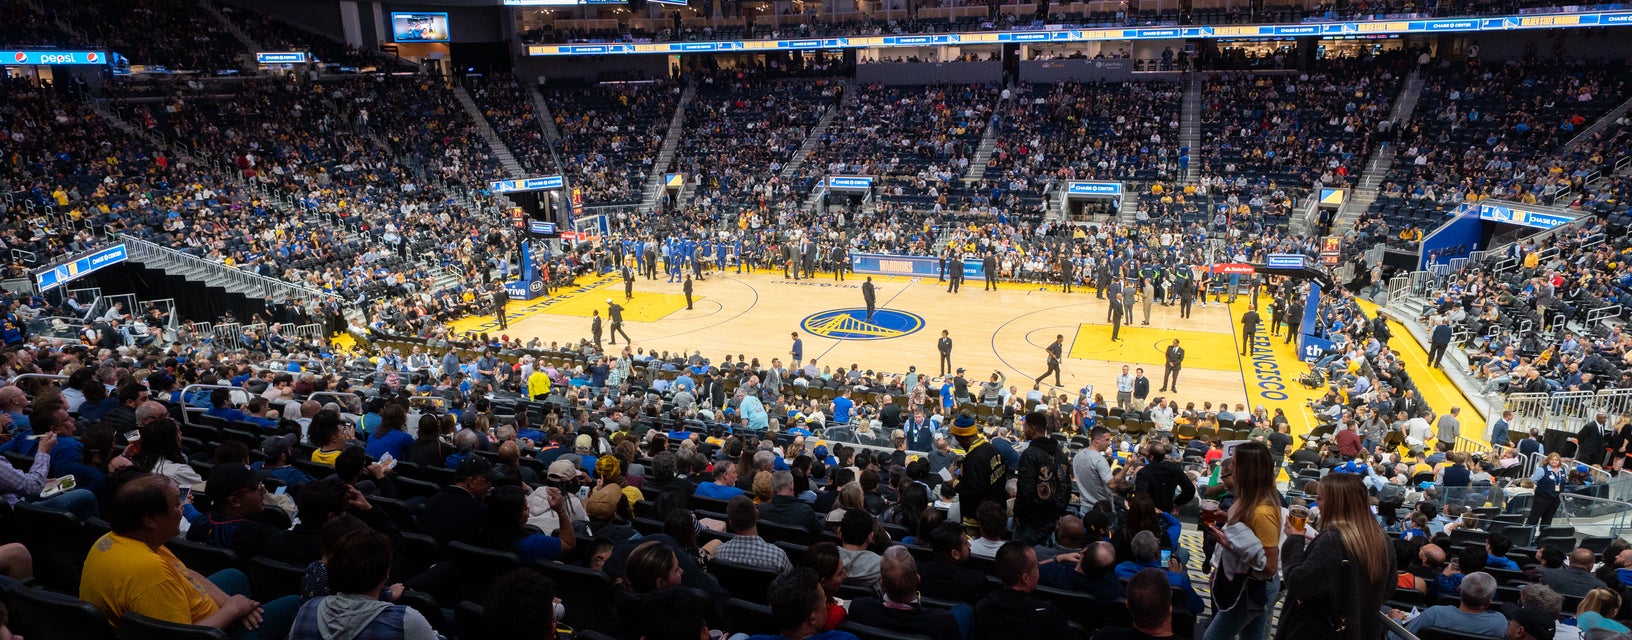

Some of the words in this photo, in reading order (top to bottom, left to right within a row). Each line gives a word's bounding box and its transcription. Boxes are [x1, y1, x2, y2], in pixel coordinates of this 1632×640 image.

[40, 52, 76, 64] pepsi
[1531, 216, 1551, 225] CHASE
[880, 260, 913, 273] WARRIORS
[1249, 335, 1288, 400] FRANCISCO
